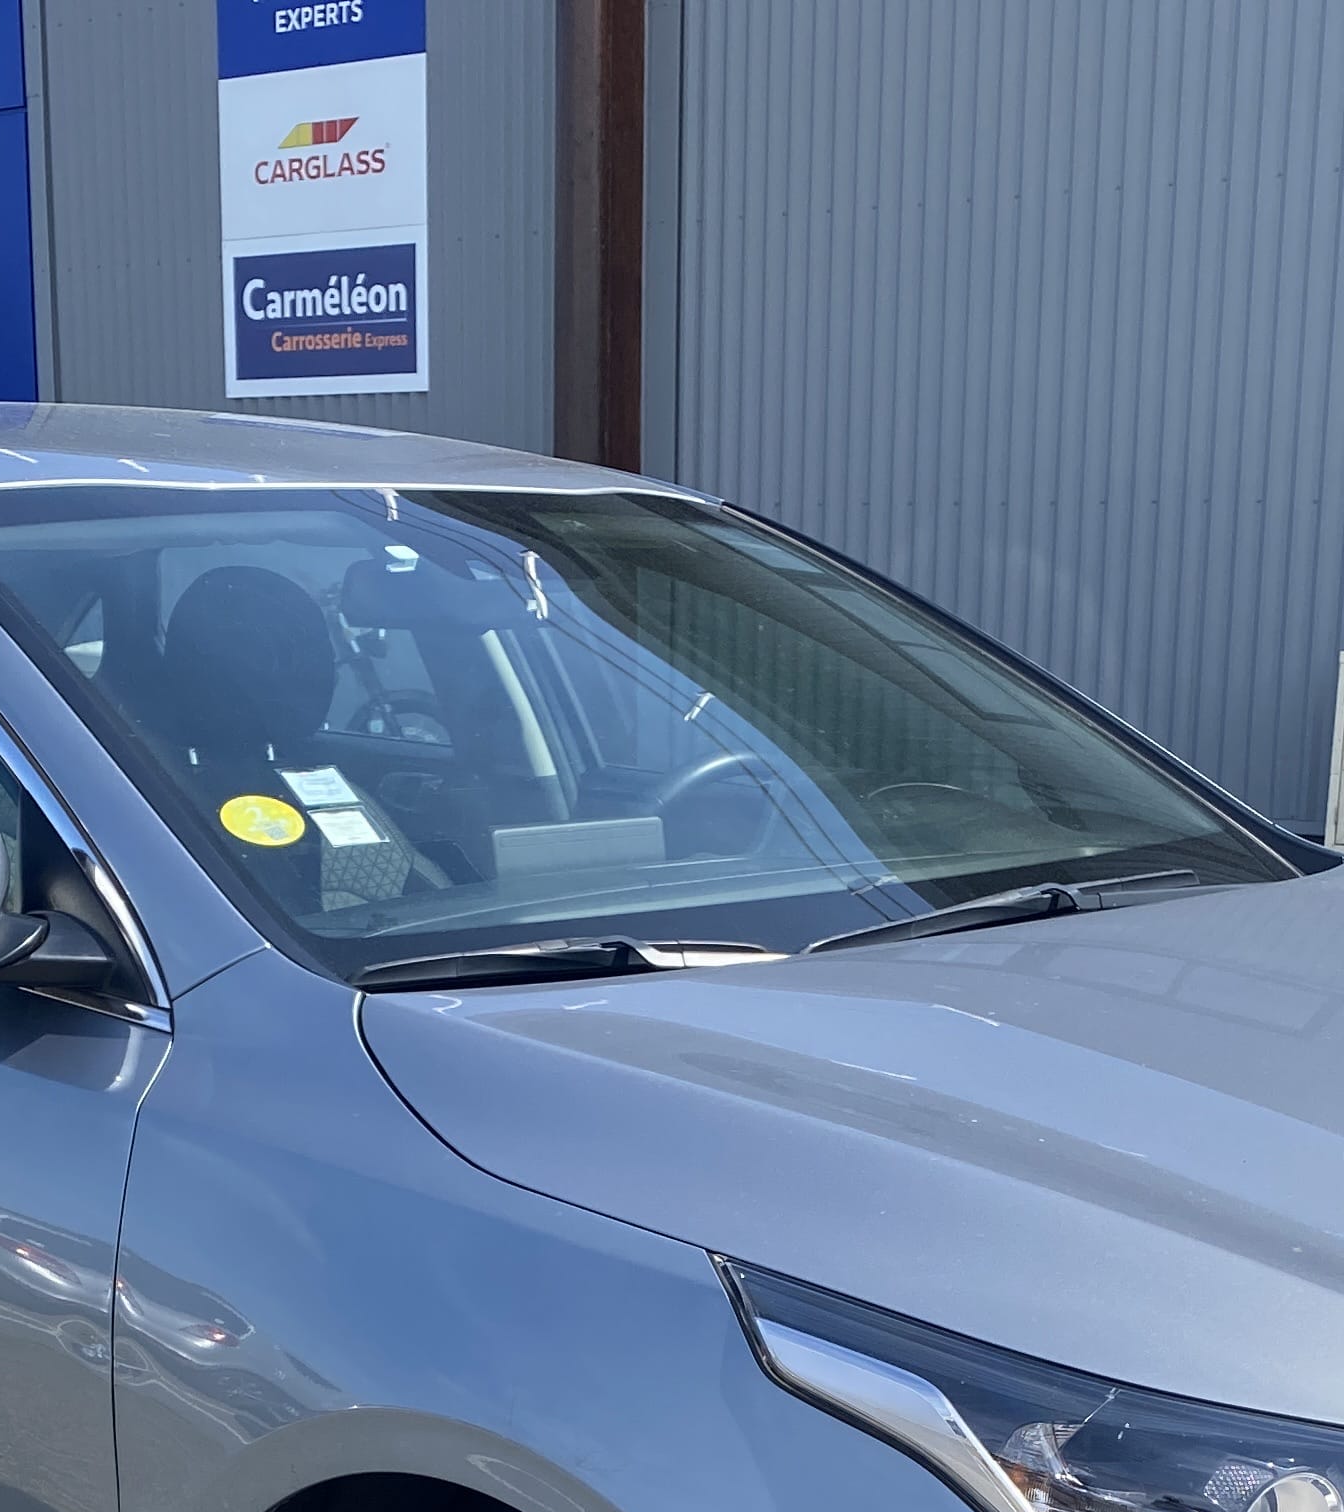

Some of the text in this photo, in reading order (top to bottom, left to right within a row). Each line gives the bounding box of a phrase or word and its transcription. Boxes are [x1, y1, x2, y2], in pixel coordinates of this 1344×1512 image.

[274, 0, 364, 33] EXPERTS
[254, 148, 386, 185] CARGLASS
[242, 273, 408, 321] Carméléon
[271, 326, 408, 352] Carrosserie Express
